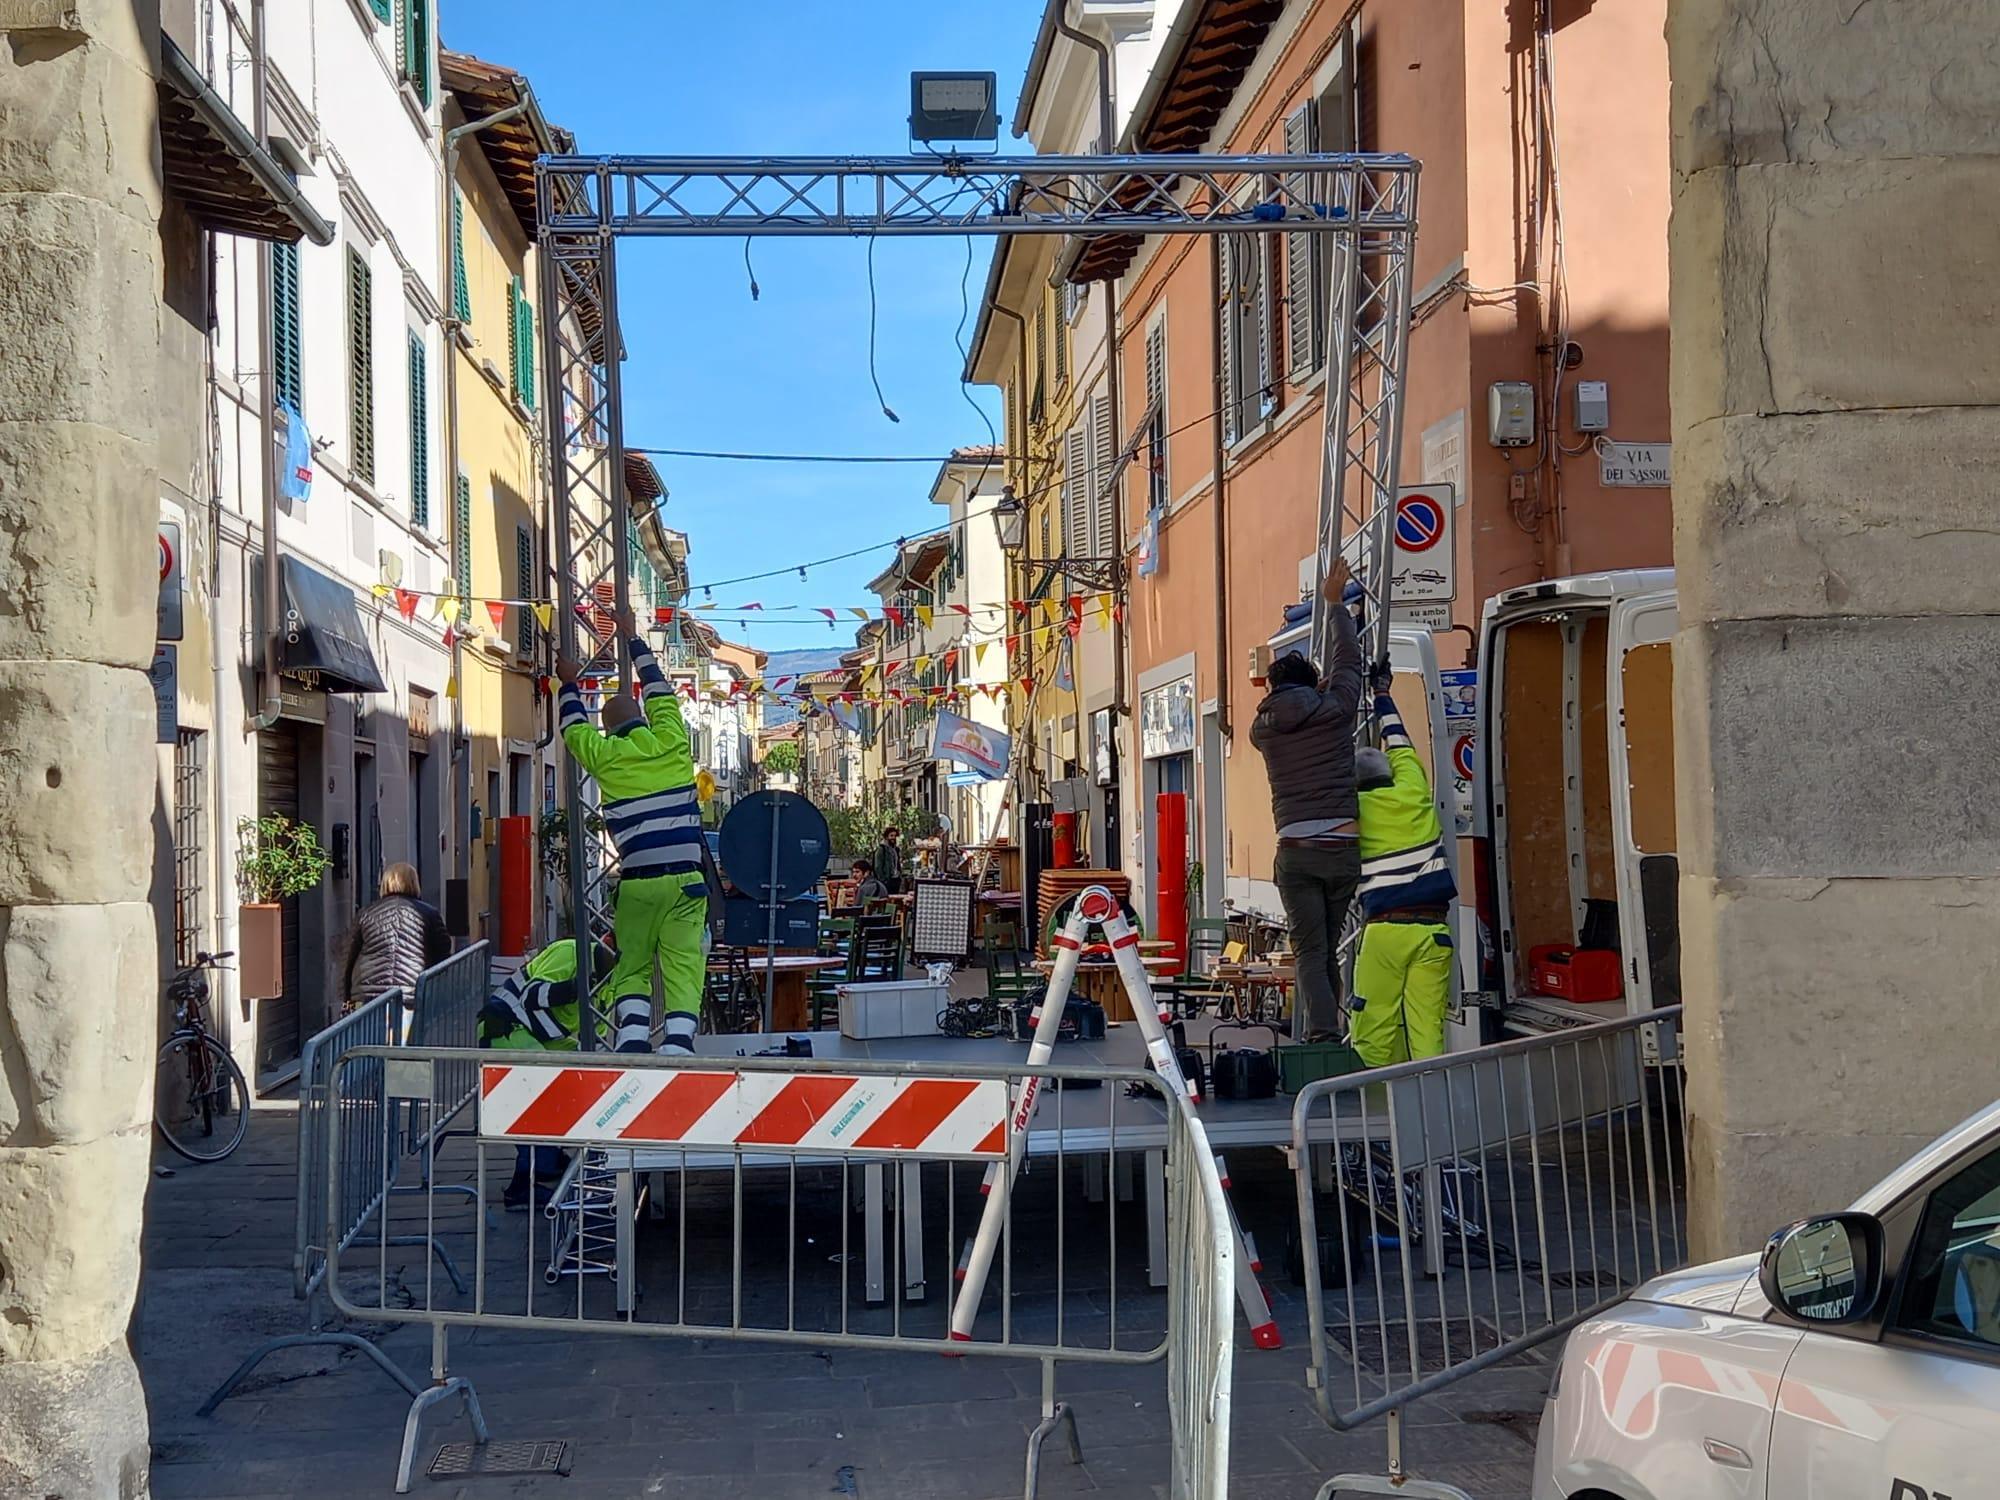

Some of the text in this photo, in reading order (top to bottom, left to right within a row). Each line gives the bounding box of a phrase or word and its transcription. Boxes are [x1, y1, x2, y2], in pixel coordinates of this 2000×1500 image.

[1627, 450, 1652, 464] VIA
[1606, 468, 1623, 481] DEI
[1422, 608, 1446, 616] ambo
[286, 609, 300, 644] ORO
